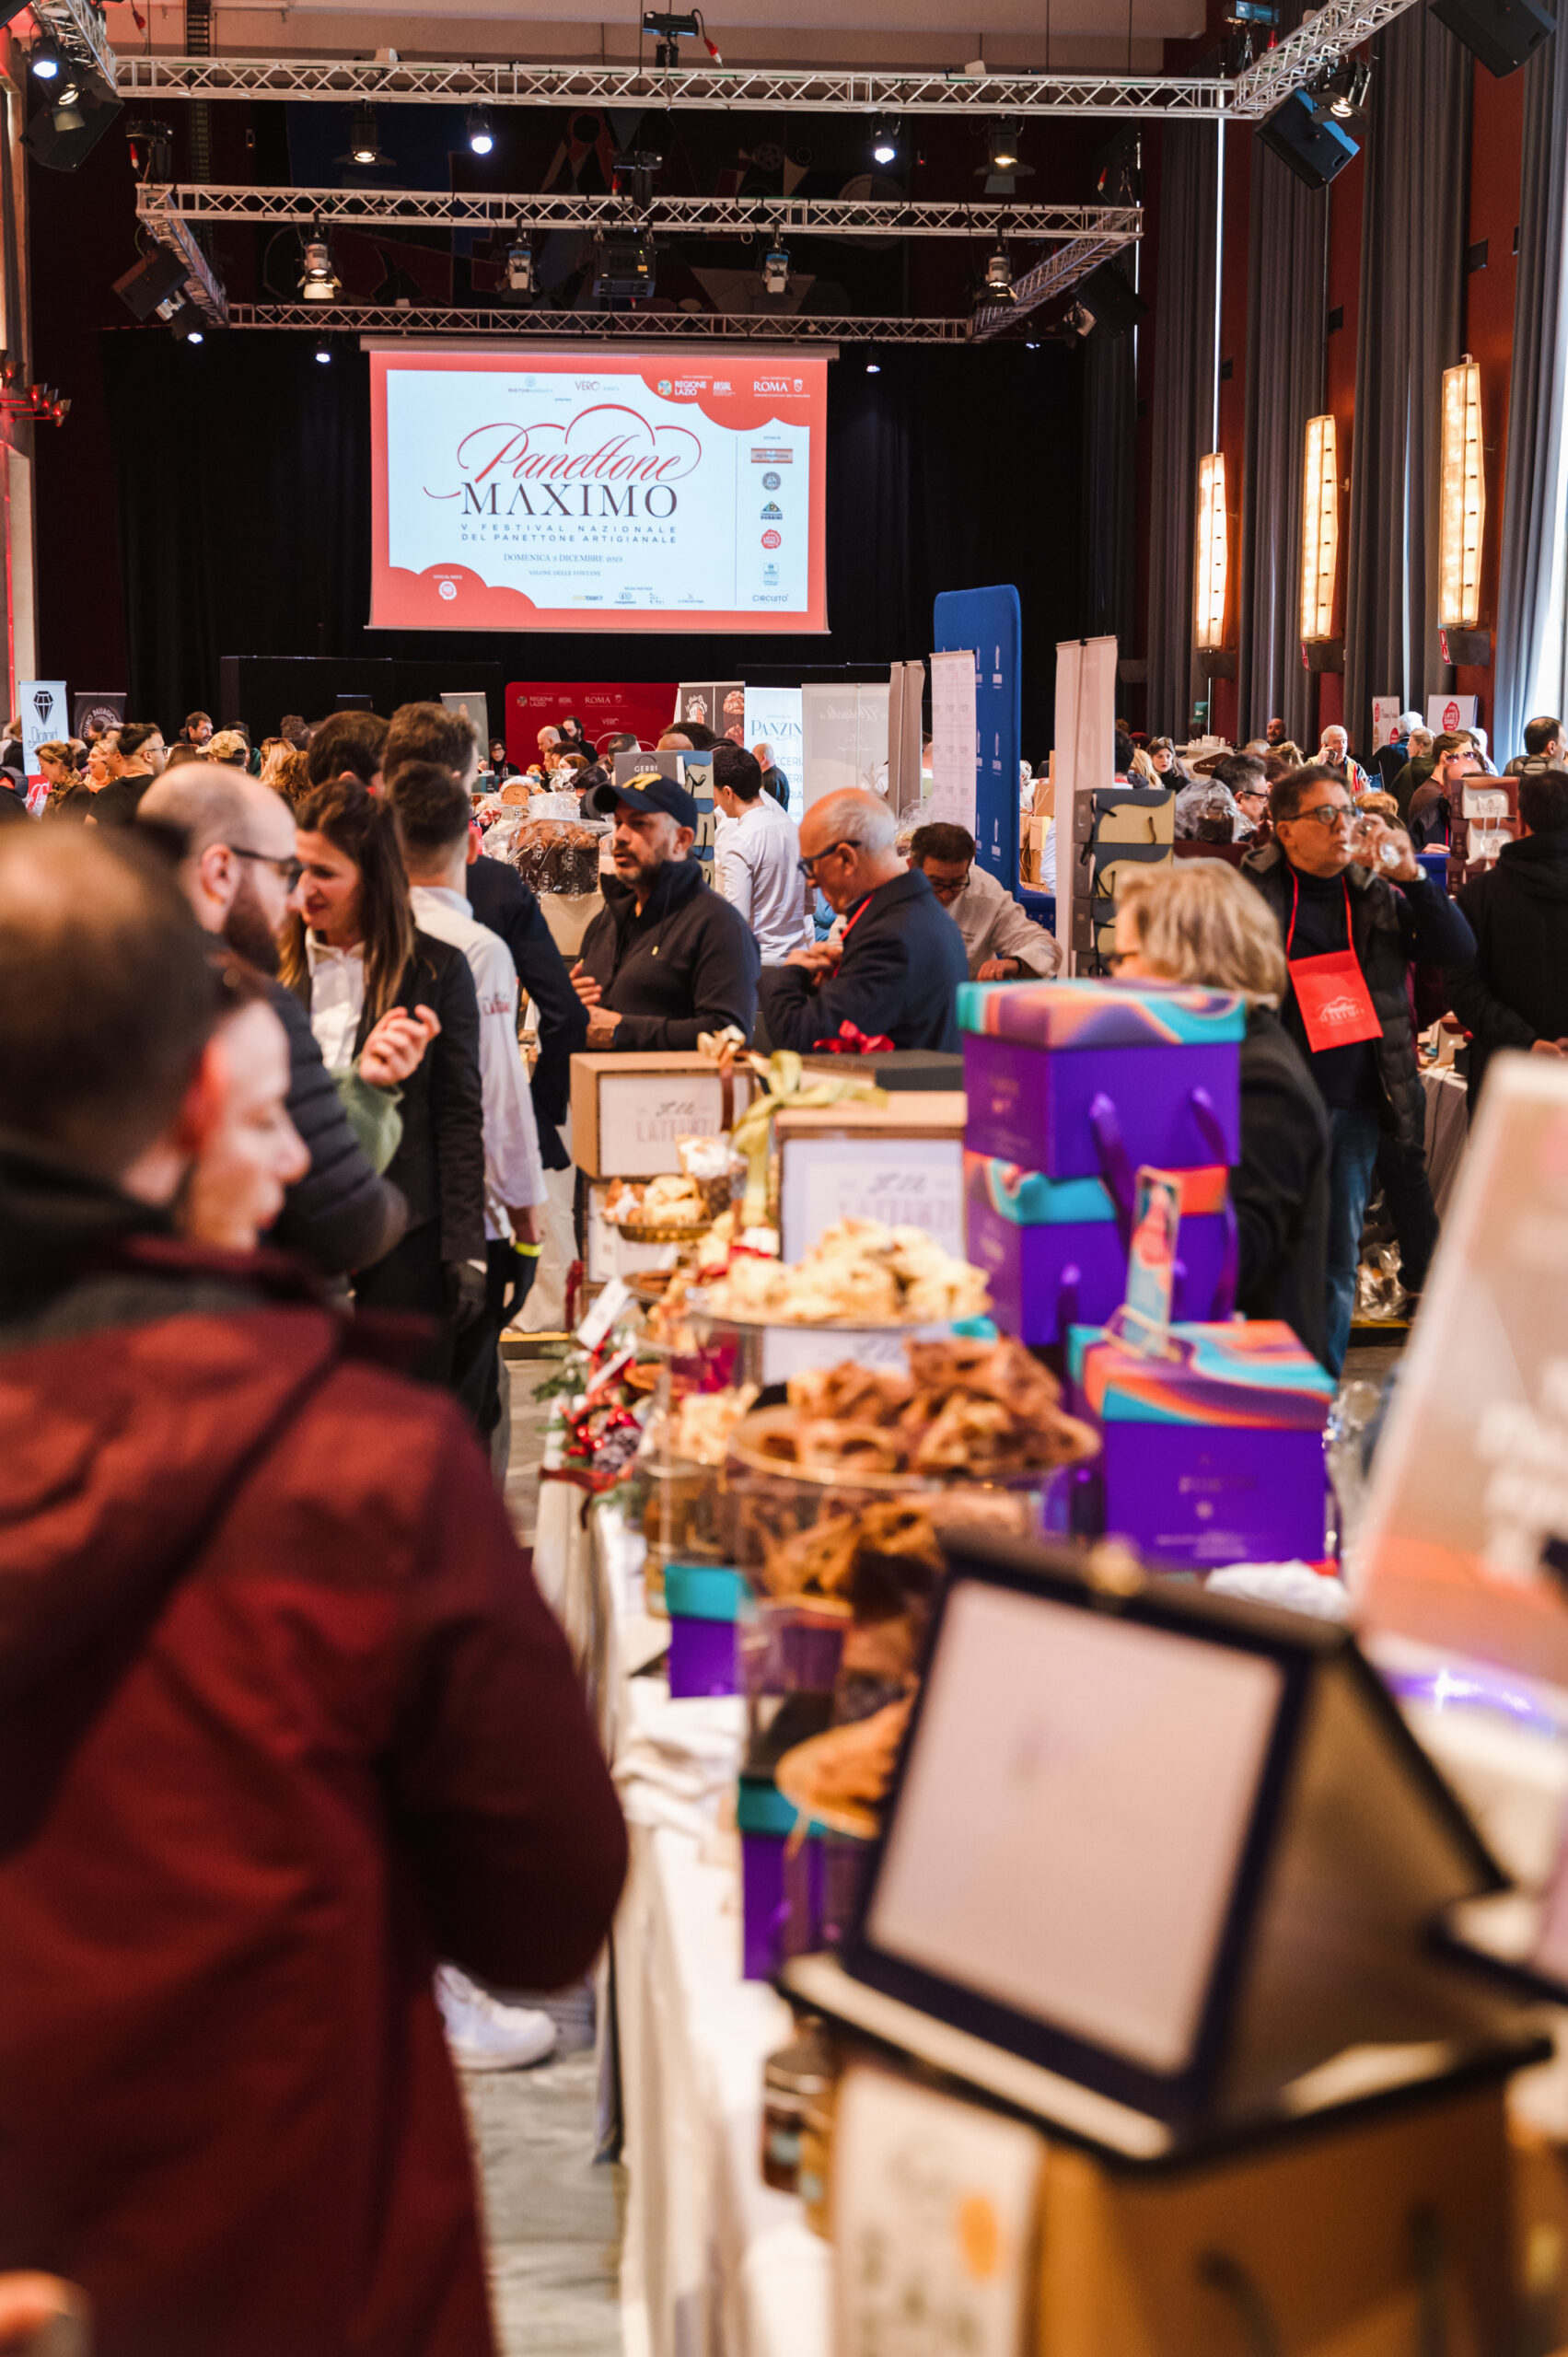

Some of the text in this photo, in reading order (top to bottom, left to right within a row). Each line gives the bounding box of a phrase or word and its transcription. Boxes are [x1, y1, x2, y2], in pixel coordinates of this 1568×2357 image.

[675, 380, 707, 389] REGIONE
[753, 381, 788, 391] ROMA
[458, 424, 692, 482] Panettone
[460, 482, 678, 518] MAXIMO
[461, 523, 468, 531] V
[578, 525, 676, 533] NAZIONALE
[494, 534, 575, 542] PANETTONE
[583, 535, 677, 543] ARTIGIANALE
[504, 553, 551, 562] DOMENICA
[559, 554, 604, 563] DICEMBRE
[585, 696, 611, 704] ROMA
